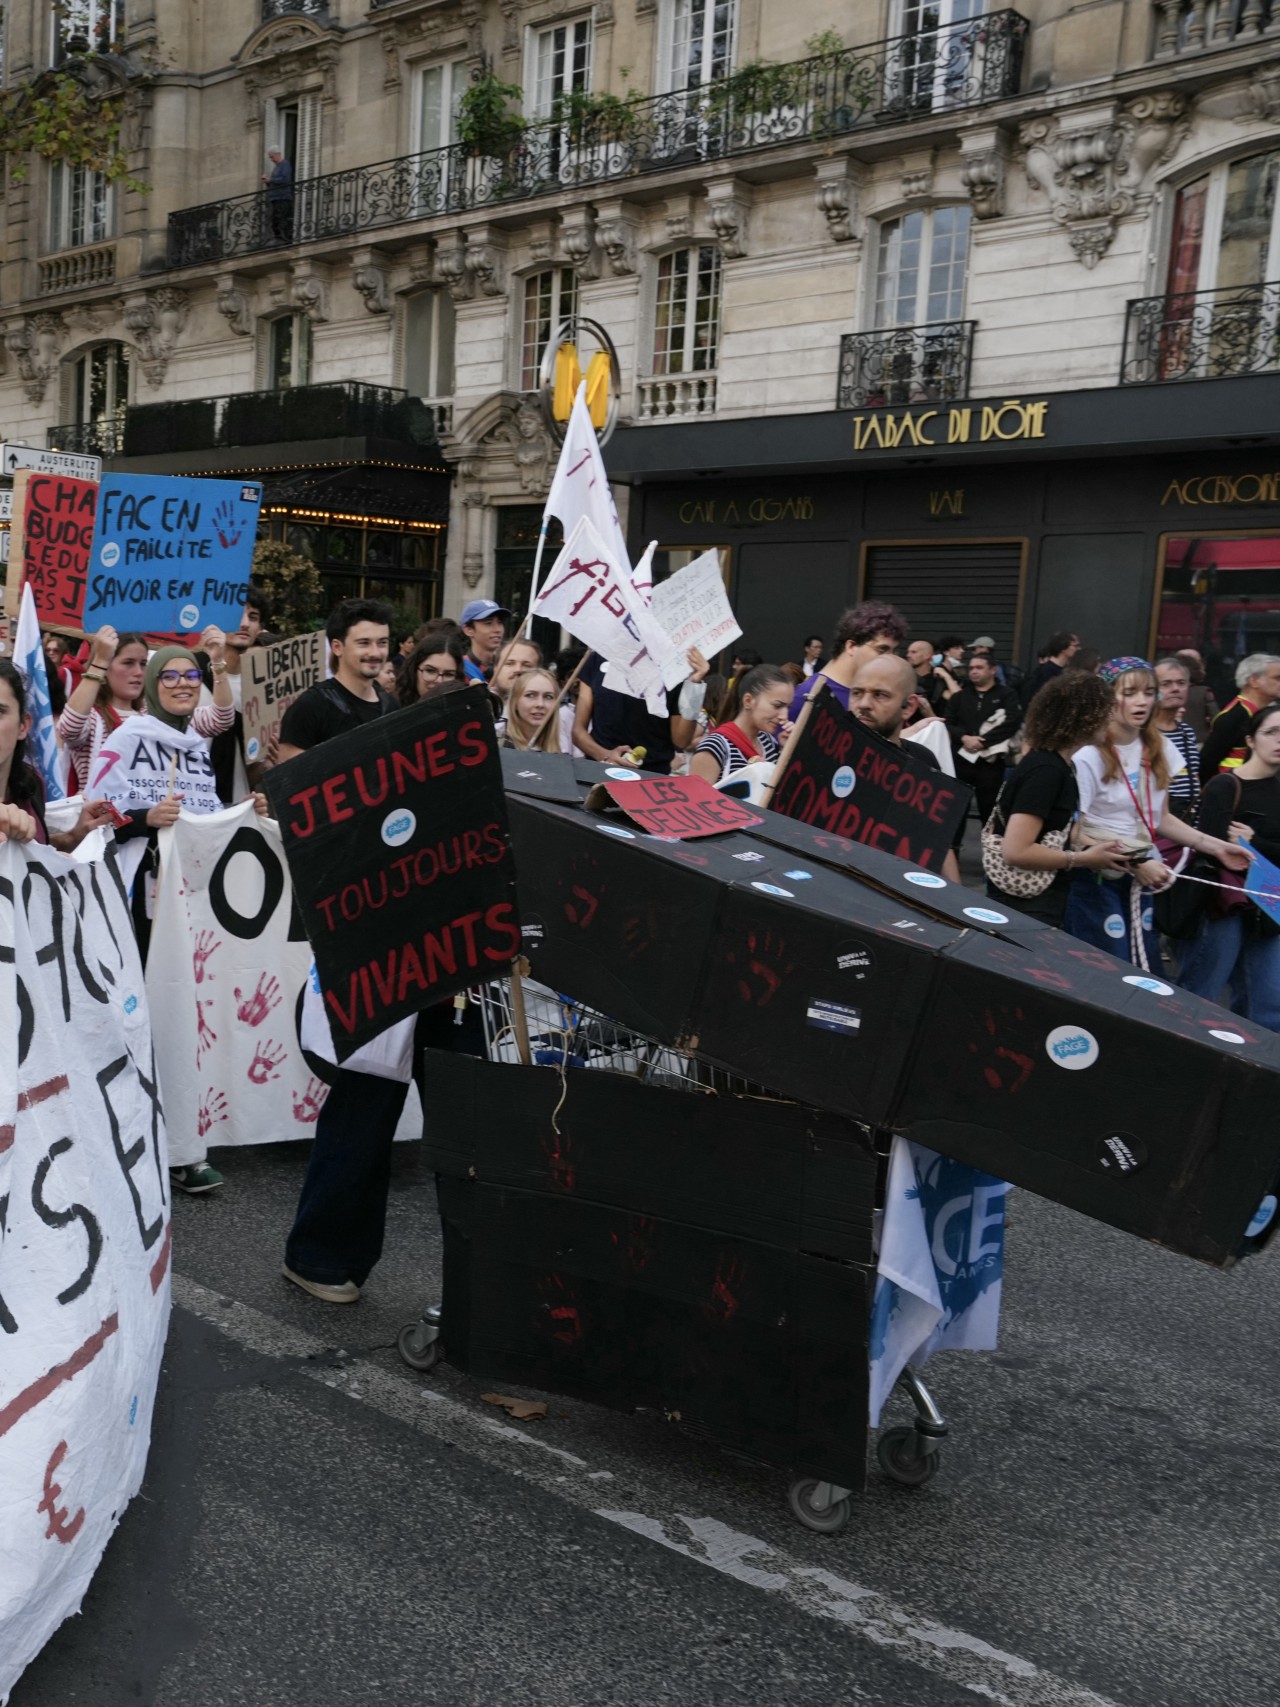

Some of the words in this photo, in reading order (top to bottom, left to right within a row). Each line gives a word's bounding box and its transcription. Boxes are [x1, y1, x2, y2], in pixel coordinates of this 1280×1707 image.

[853, 410, 938, 450] TABAC
[947, 408, 971, 443] DU
[40, 453, 96, 471] AUSTERLITZ
[102, 490, 157, 536] FAC
[161, 498, 201, 533] EN
[167, 579, 195, 600] EN
[251, 634, 320, 685] LIBERTÉ
[290, 721, 489, 838] JEUNES
[811, 709, 854, 763] POUR
[855, 746, 955, 824] ENCORE
[629, 798, 756, 834] JEUNES
[639, 782, 690, 806] LES
[316, 822, 506, 932] TOUJOURS
[325, 902, 521, 1035] VIVANTS
[1058, 1038, 1089, 1055] FAGE
